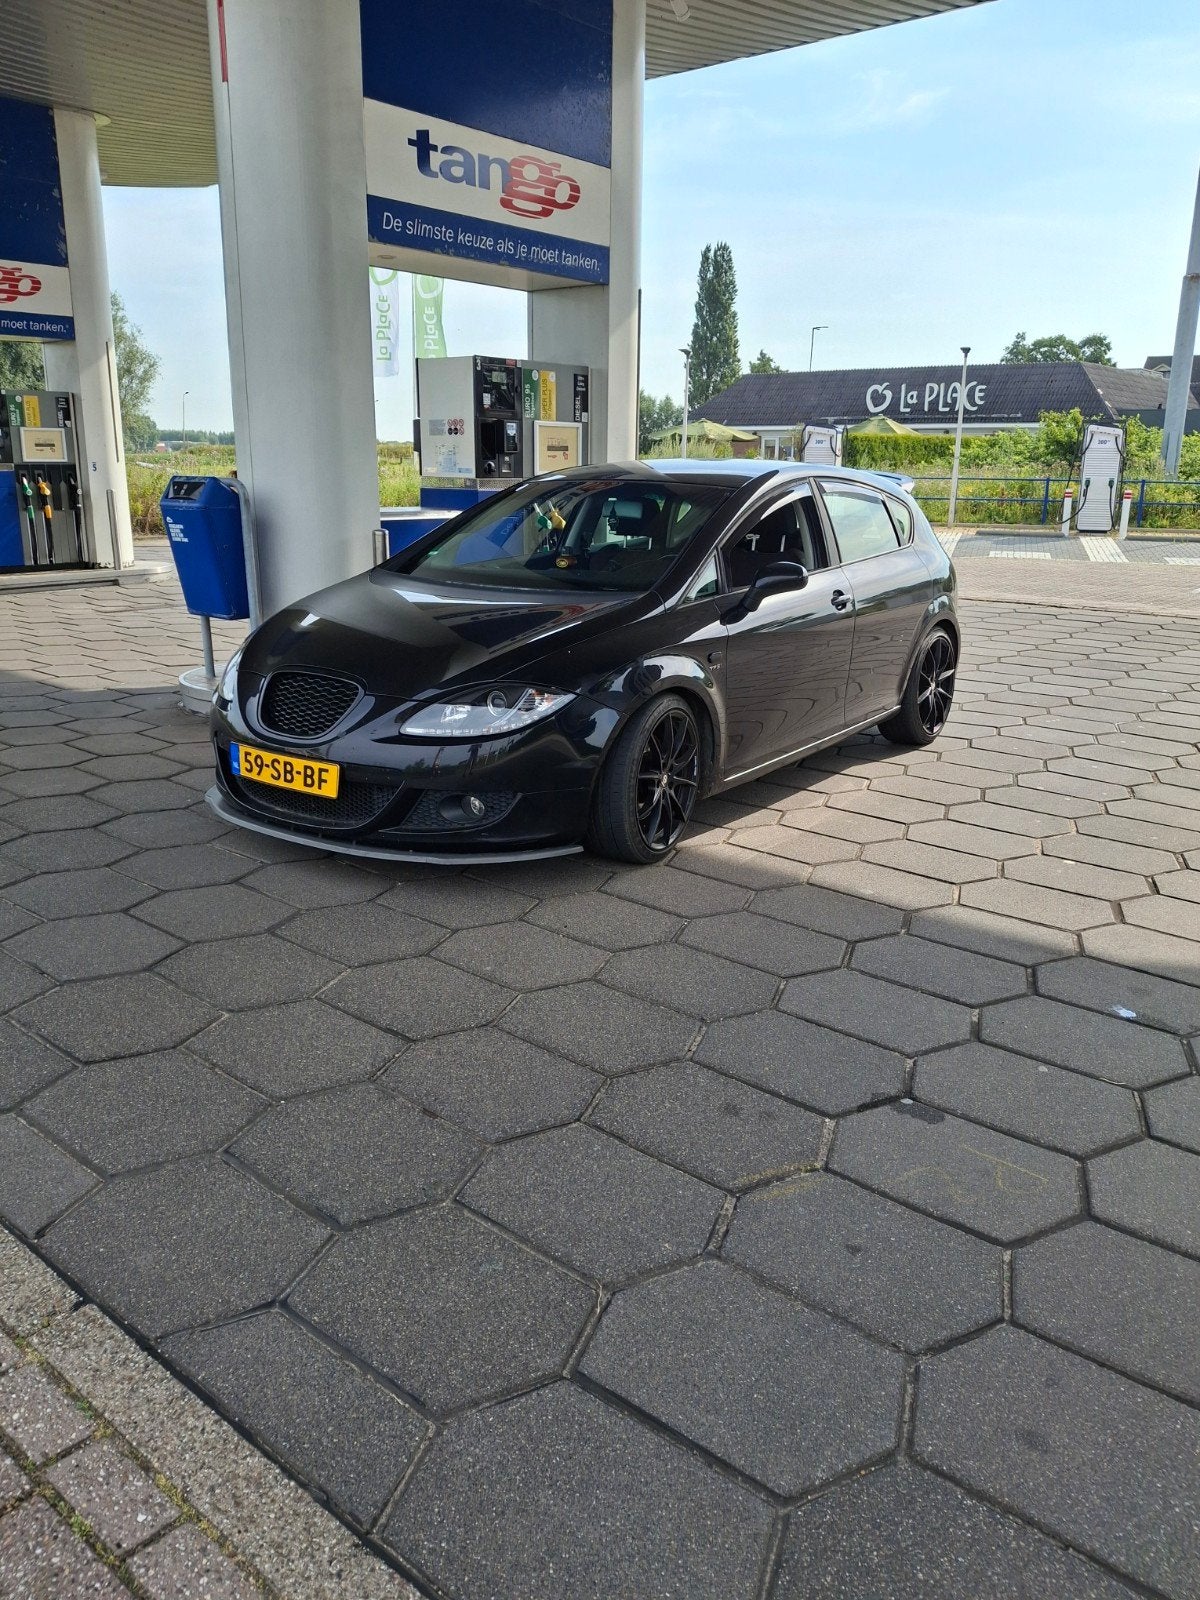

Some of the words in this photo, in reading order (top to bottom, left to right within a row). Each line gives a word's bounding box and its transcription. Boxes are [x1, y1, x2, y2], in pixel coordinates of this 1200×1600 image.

[407, 129, 581, 220] tango
[382, 211, 402, 232] De
[406, 218, 454, 243] slimste
[457, 227, 494, 251] keuze
[496, 236, 514, 255] als
[515, 239, 528, 257] je
[530, 245, 559, 264] moet
[561, 250, 600, 272] tanken.
[1, 319, 28, 330] moet
[376, 345, 391, 361] La
[900, 383, 918, 412] La
[244, 751, 329, 790] 59-SB-BF
